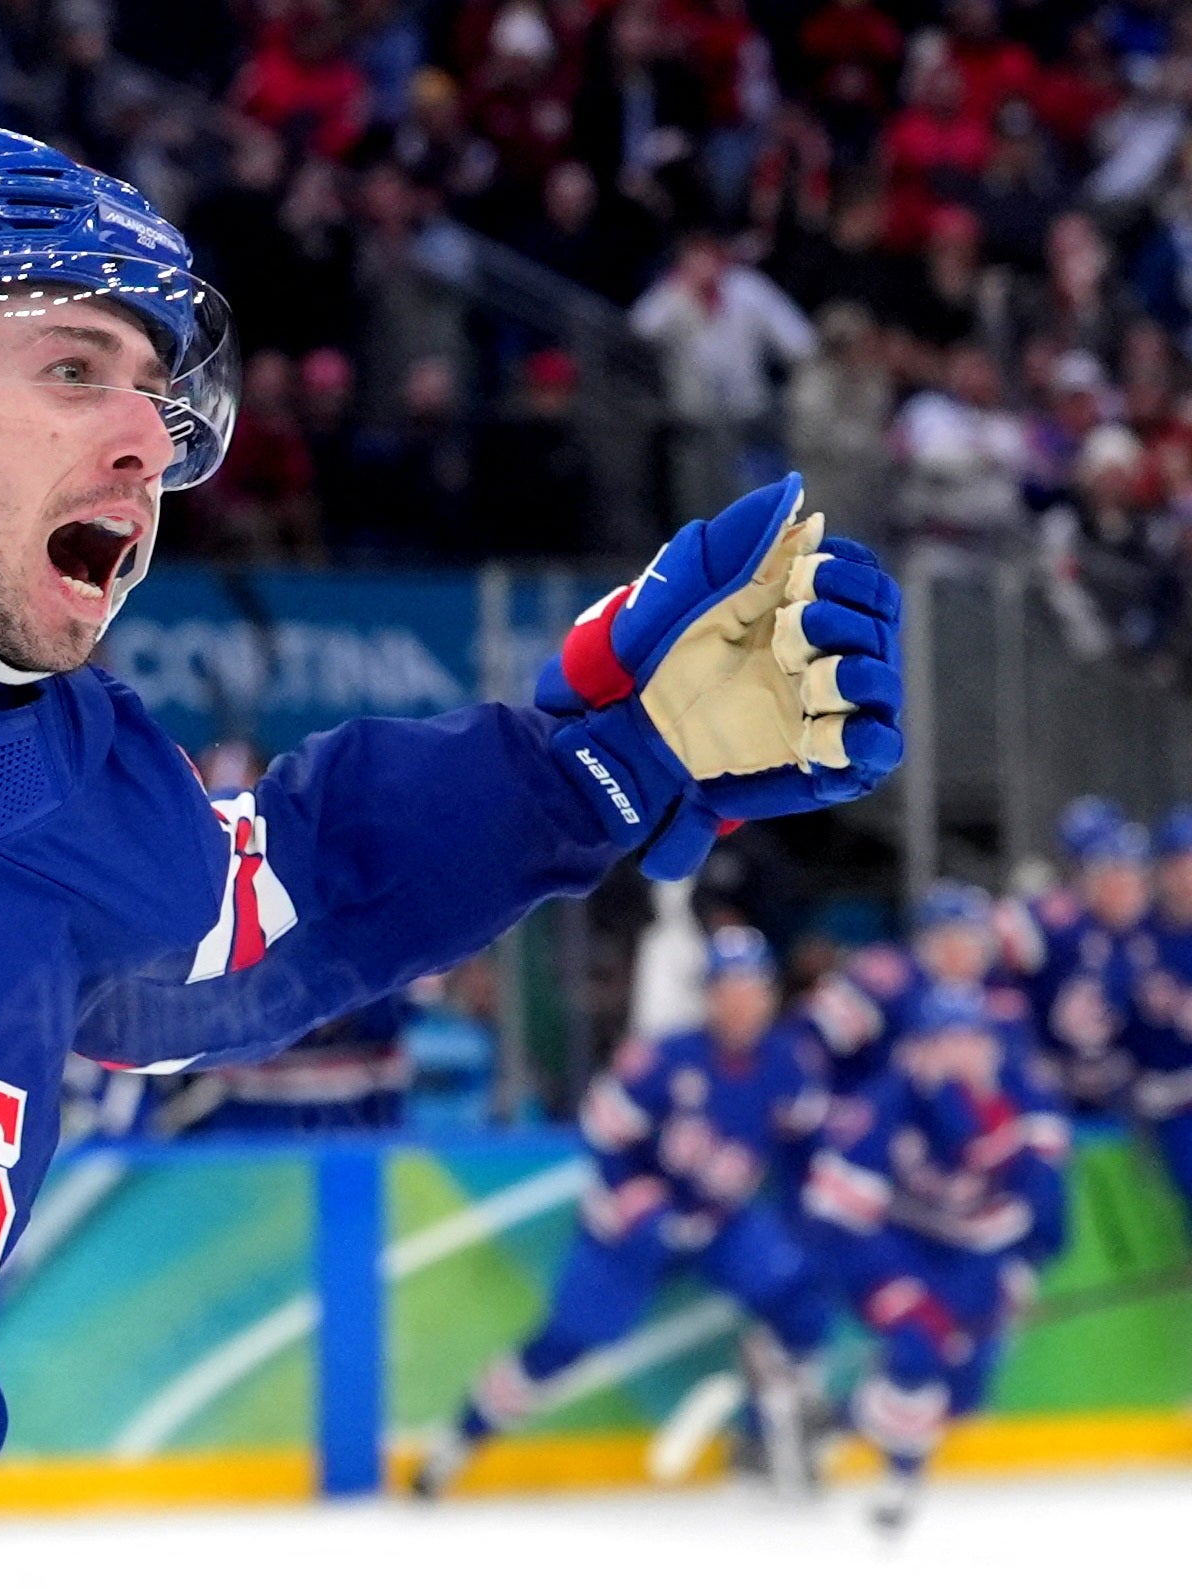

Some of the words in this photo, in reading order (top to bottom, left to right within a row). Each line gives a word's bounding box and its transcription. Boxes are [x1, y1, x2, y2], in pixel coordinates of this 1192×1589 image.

[106, 212, 146, 234] MILANO
[137, 233, 157, 250] 2026
[575, 747, 641, 825] BAUER
